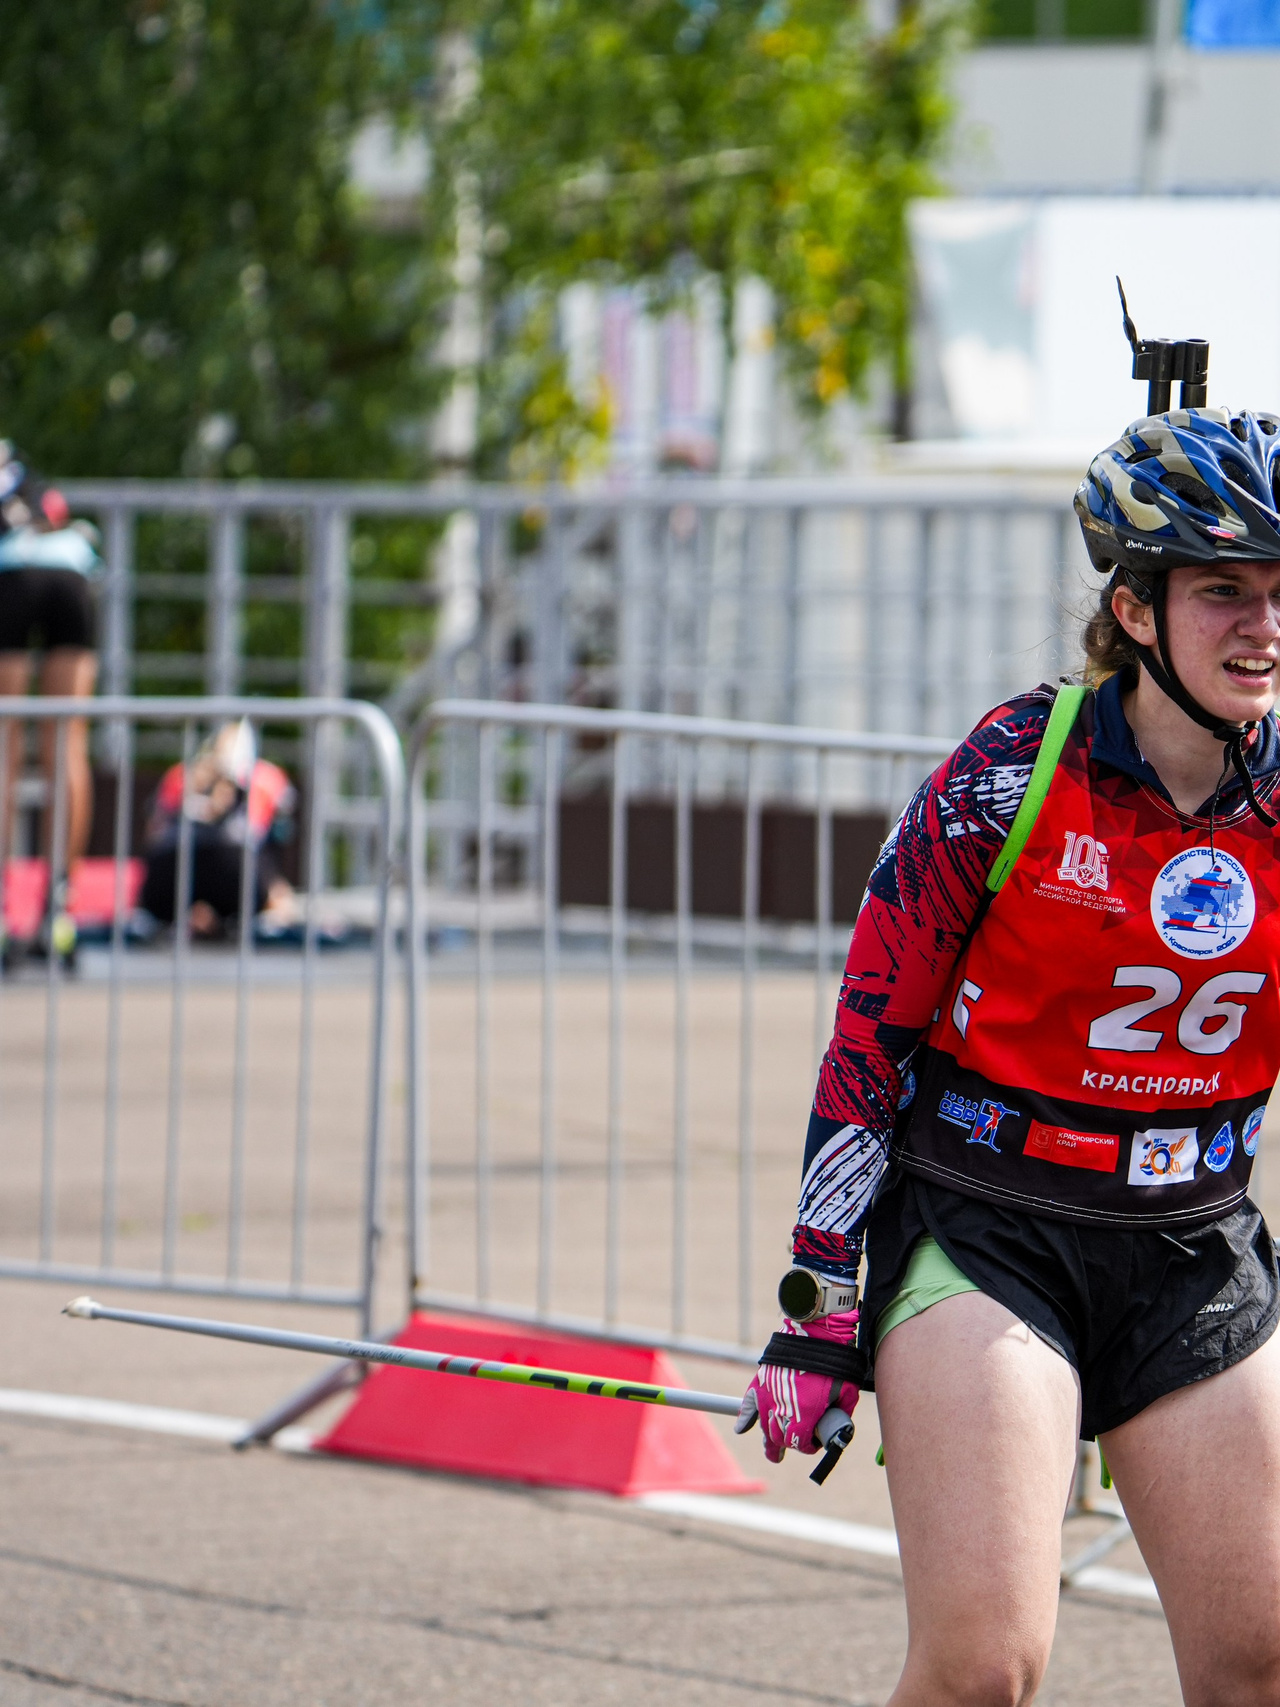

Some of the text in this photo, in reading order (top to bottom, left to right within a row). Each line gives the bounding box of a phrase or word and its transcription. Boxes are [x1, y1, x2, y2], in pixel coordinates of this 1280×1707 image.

[1159, 849, 1247, 882] ПЕРВЕНСТВО РОССИИ
[1033, 888, 1126, 913] РОССИЙСКОЙ ФЕДЕРАЦИИ
[1039, 882, 1123, 905] МИНИСТЕРСТВО СПОРТА
[1168, 936, 1214, 956] Красноярск
[1216, 935, 1237, 952] 2023
[1086, 964, 1268, 1055] 26
[1081, 1068, 1222, 1096] КРАСНОЯРСК
[939, 1097, 977, 1121] СБР
[1056, 1138, 1077, 1149] КРАЙ
[1057, 1132, 1115, 1146] КРАСНОЯРСКИЙ
